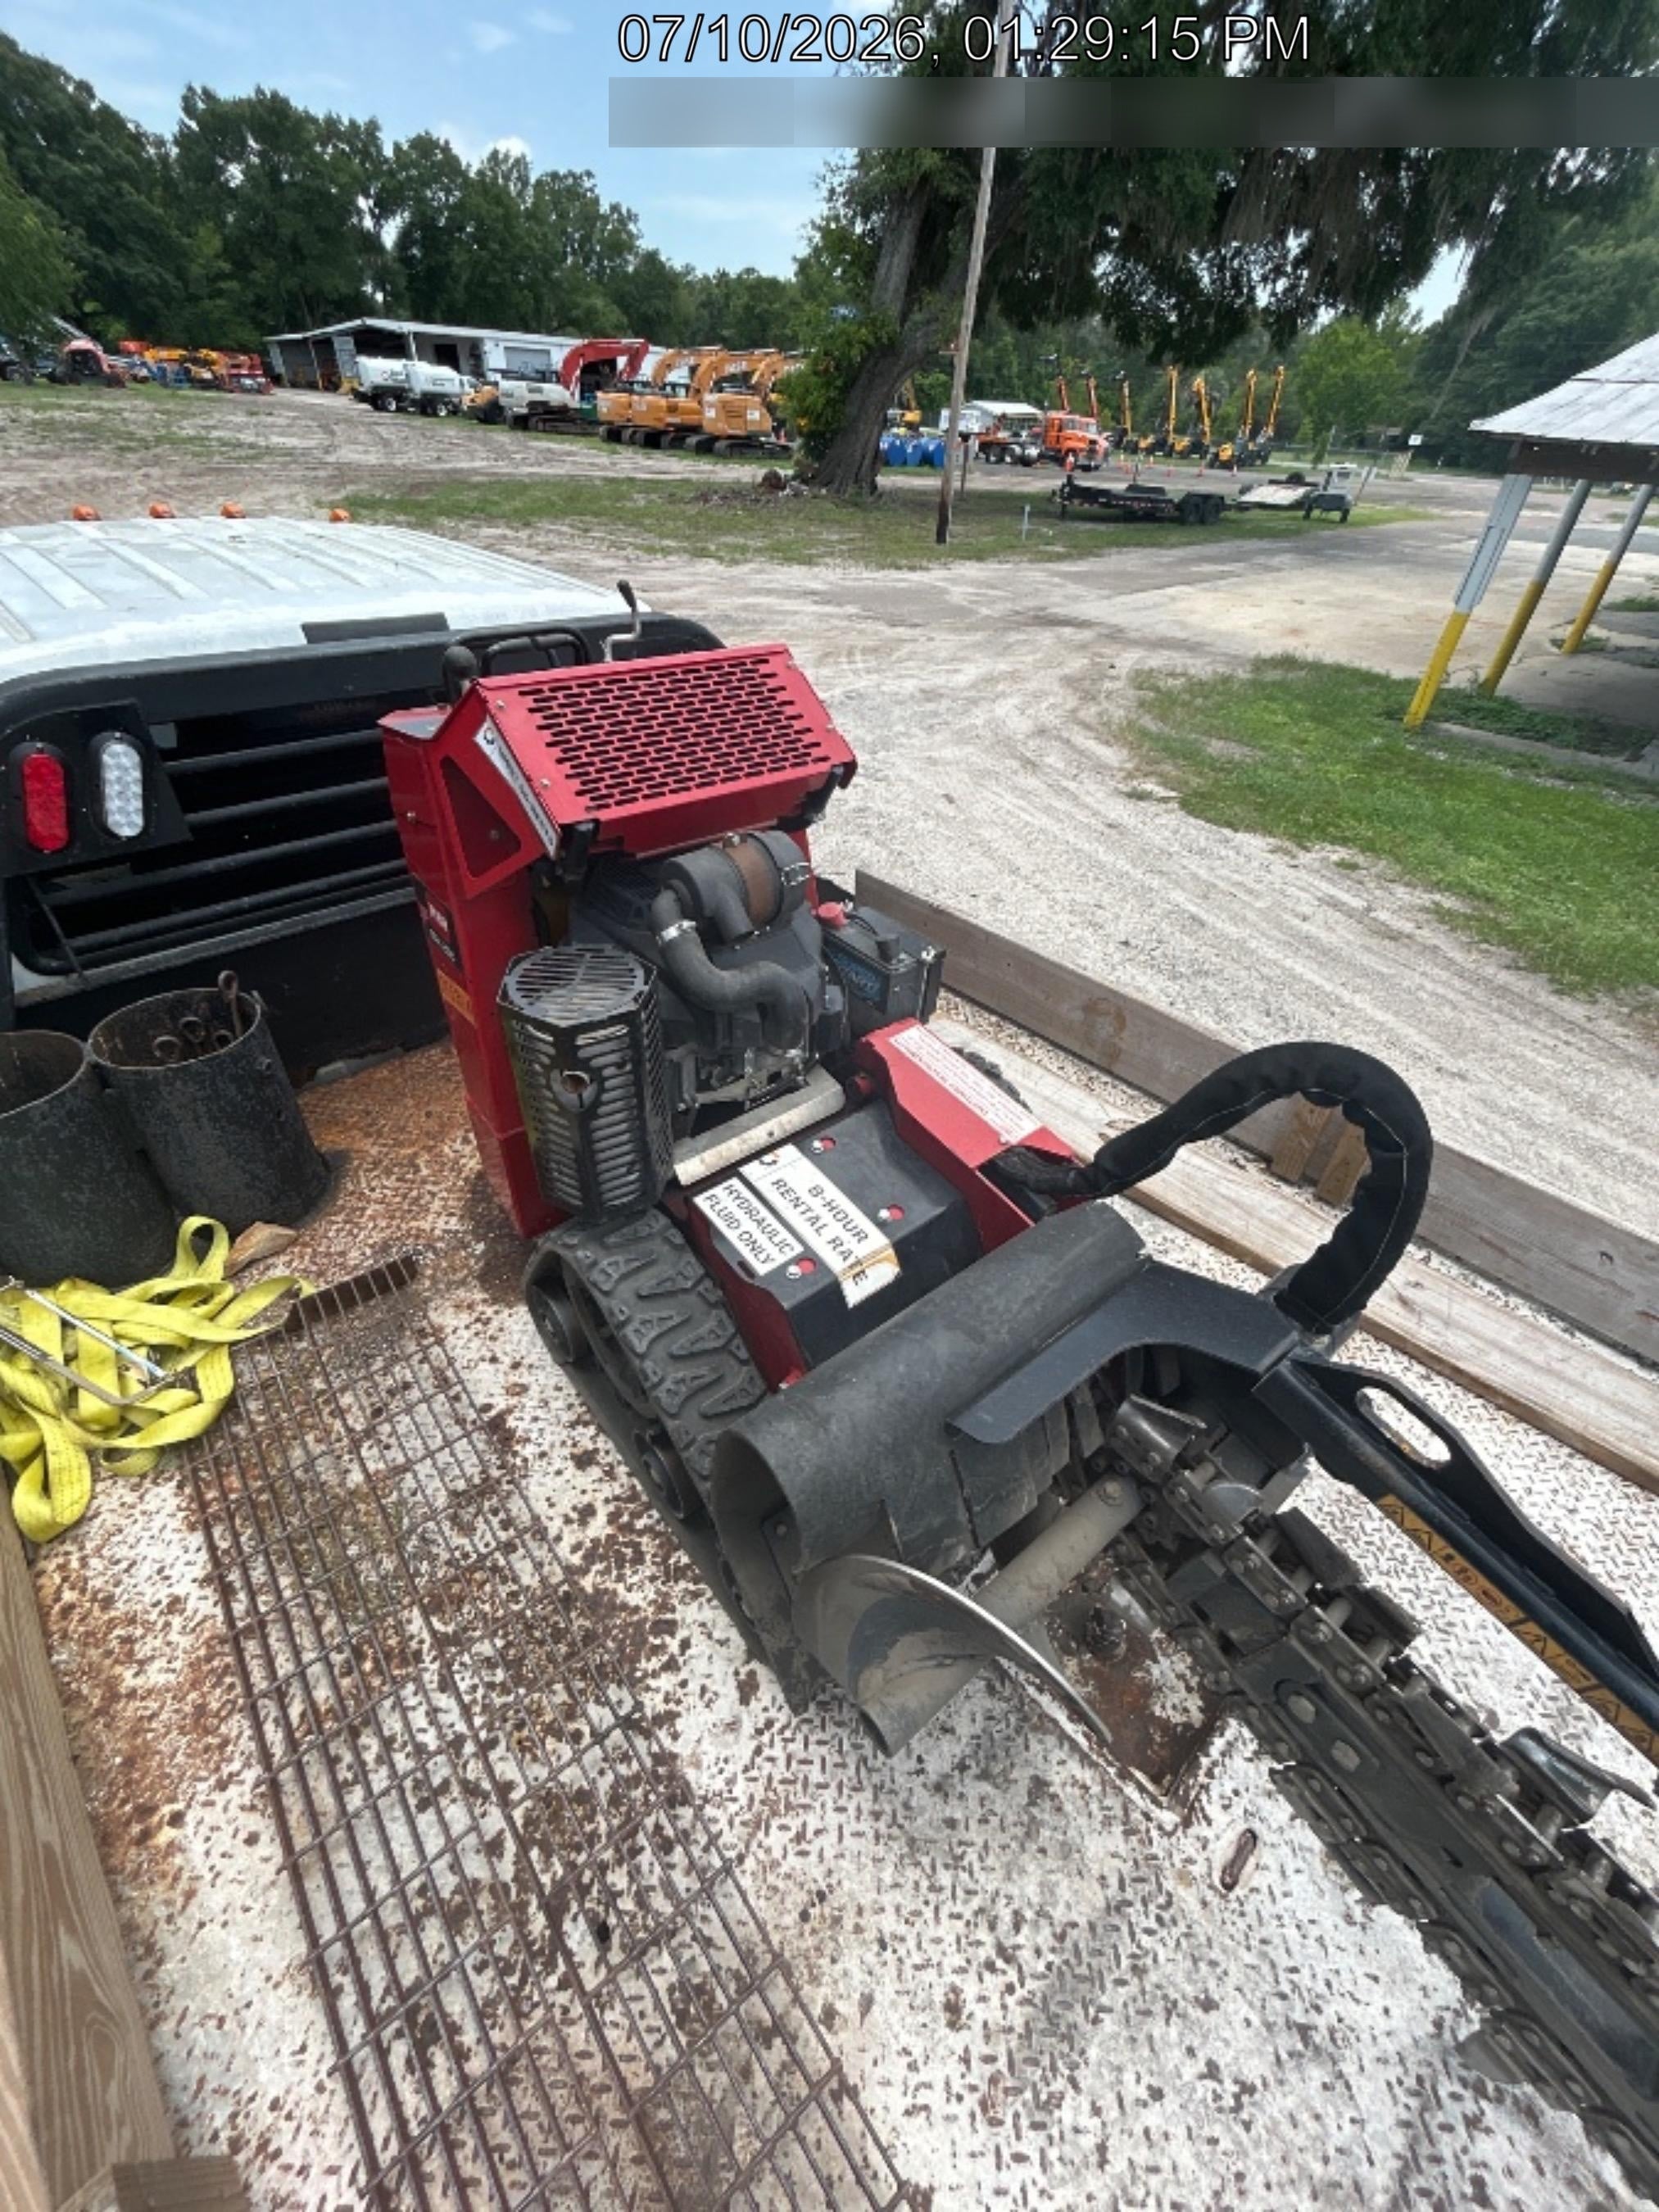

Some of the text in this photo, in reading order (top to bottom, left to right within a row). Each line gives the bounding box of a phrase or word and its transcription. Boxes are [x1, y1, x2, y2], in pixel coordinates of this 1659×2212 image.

[705, 1194, 775, 1263] FLUID ONLY
[723, 1184, 795, 1255] HYDRAULIC
[772, 1179, 828, 1236] RENTAL
[808, 1184, 869, 1244] 8-HOUR
